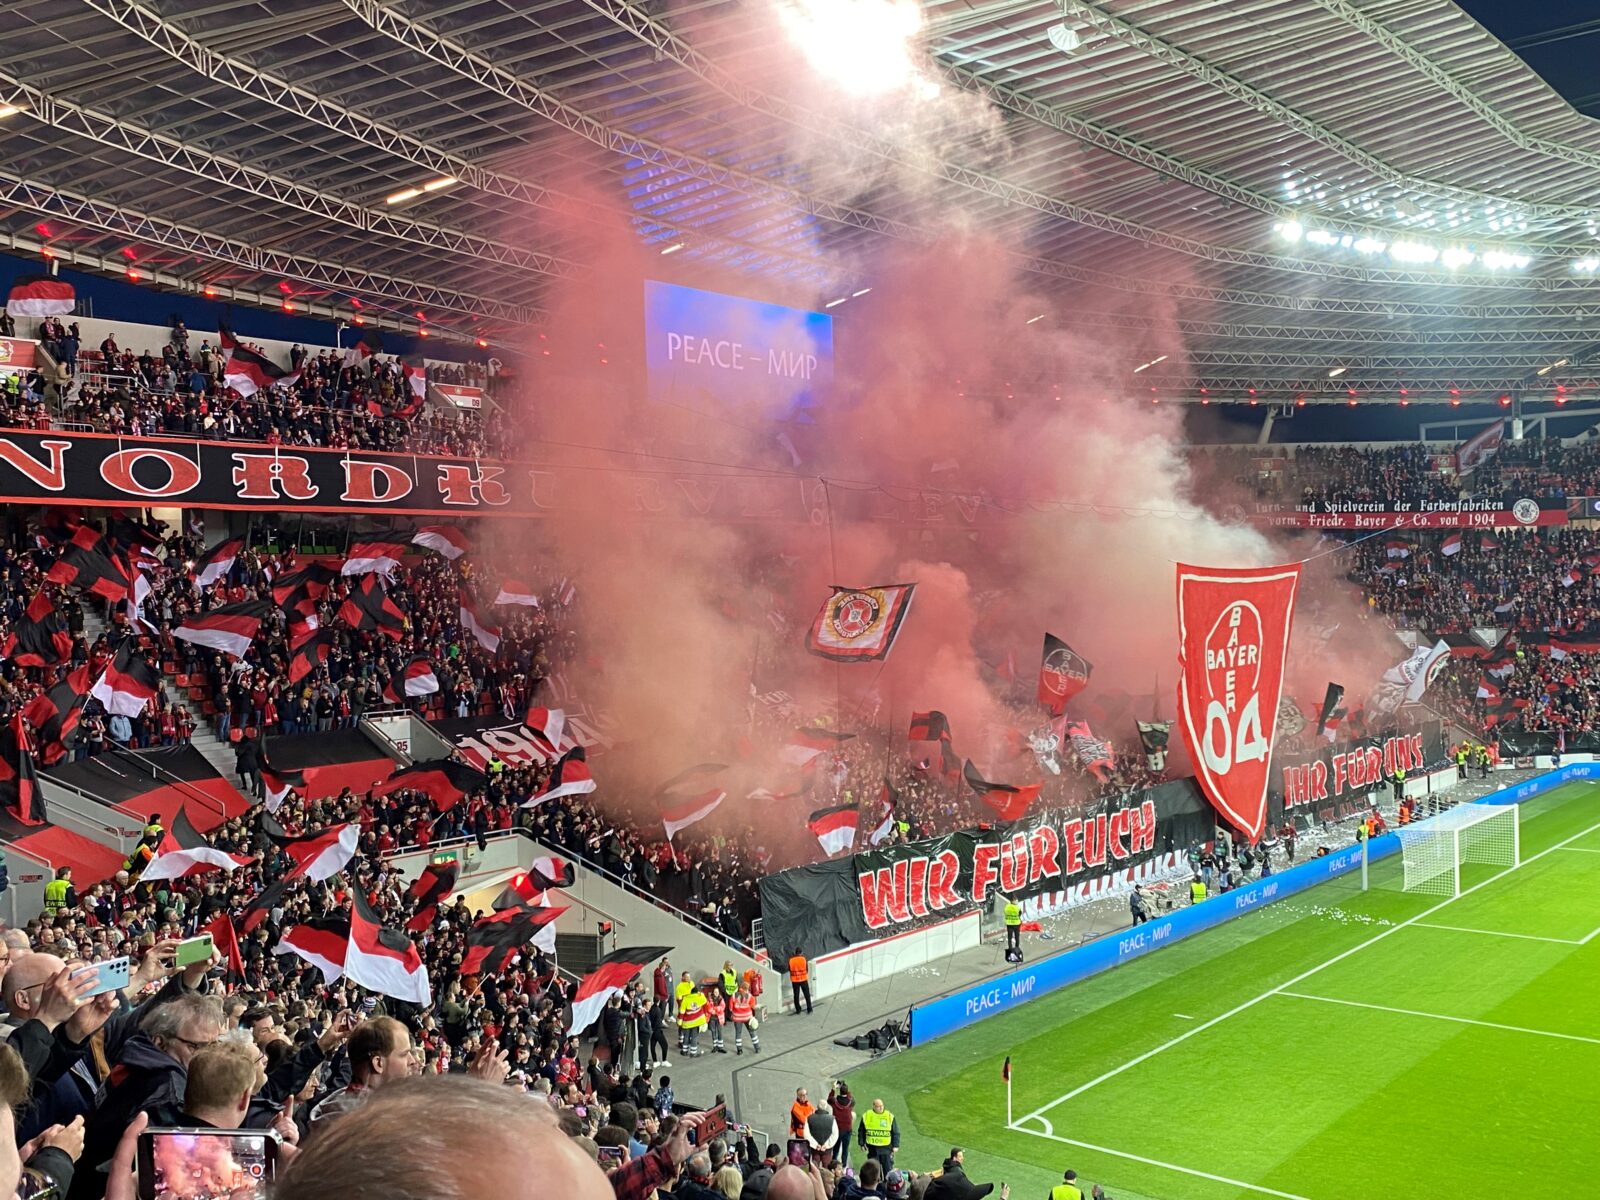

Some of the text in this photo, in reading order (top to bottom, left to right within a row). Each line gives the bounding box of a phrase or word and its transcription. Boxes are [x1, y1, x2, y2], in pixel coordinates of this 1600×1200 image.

[667, 332, 744, 370] PEACE
[768, 349, 817, 380] МИР
[1295, 501, 1316, 513] und
[1325, 500, 1385, 515] Spielverein
[1394, 499, 1411, 512] der
[1420, 499, 1504, 515] Farbenfabriken
[1309, 514, 1346, 527] Friedr.
[1355, 514, 1386, 528] Bayer
[1413, 513, 1431, 526] Co.
[1440, 516, 1458, 526] von
[1468, 513, 1495, 526] 1904
[1207, 643, 1257, 670] BAYER
[1203, 692, 1269, 775] 04
[1283, 760, 1328, 810] IHR
[1333, 746, 1383, 796] FÜR
[1383, 732, 1424, 778] UNS
[859, 849, 965, 929] WIR
[972, 825, 1061, 902] FÜR
[1064, 800, 1156, 875] EUCH
[1236, 890, 1257, 909] PEACE
[1119, 933, 1144, 955] PEACE
[1152, 923, 1172, 941] МИР
[966, 988, 1000, 1016] PEACE
[1011, 975, 1035, 998] МИР
